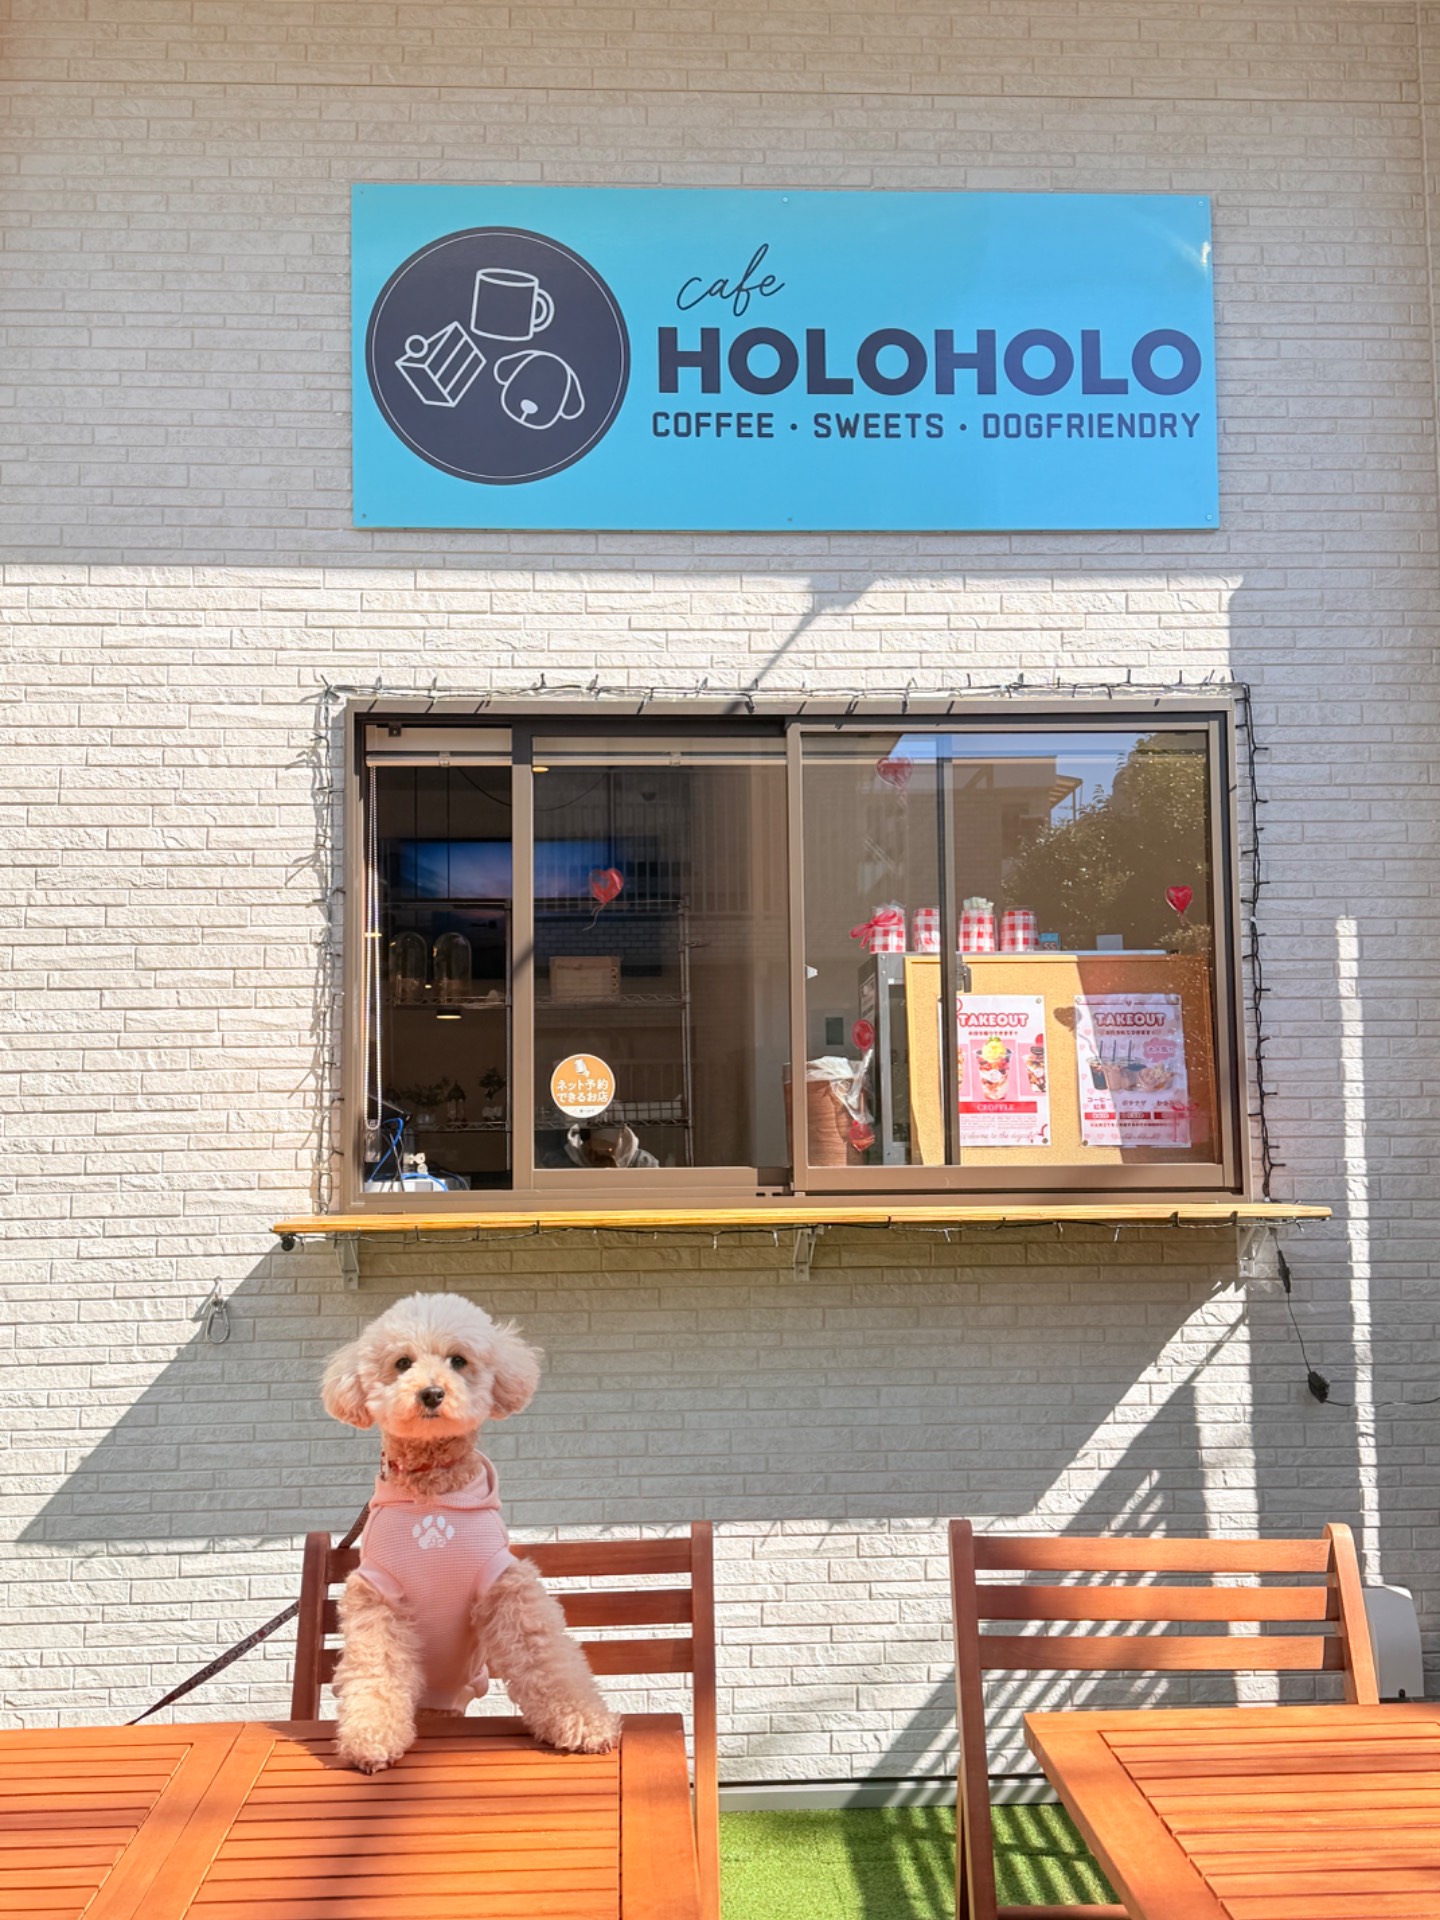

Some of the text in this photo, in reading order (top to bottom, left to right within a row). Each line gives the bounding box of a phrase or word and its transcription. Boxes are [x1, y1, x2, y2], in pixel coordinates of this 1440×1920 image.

[676, 243, 785, 317] cafe
[657, 326, 1202, 396] HOLOHOLO
[652, 411, 1201, 439] COFFEE SWEETS DOGFRIENDRY
[957, 1012, 1029, 1028] TAKEOUT
[1094, 1012, 1166, 1027] TAKEOUT
[556, 1078, 609, 1091] ネット予約
[556, 1091, 609, 1103] できるお店
